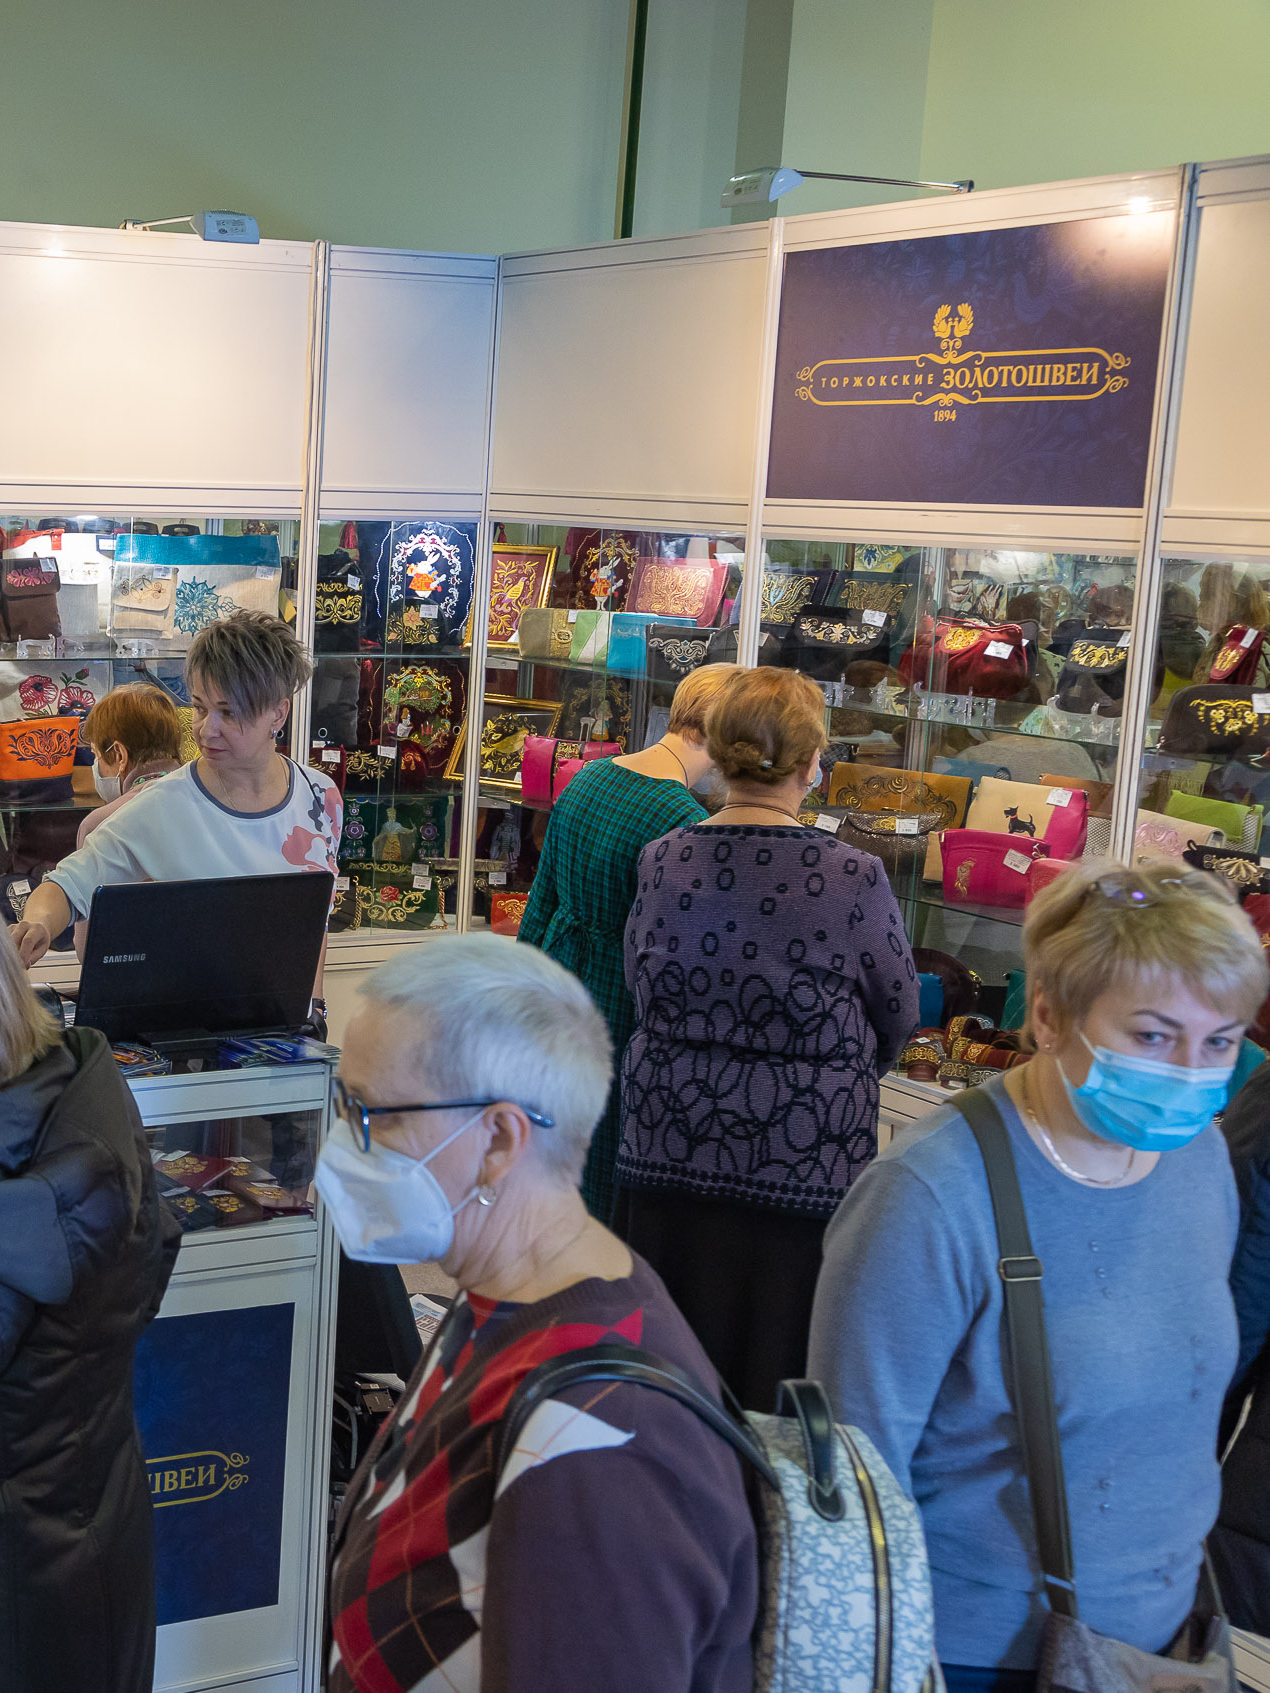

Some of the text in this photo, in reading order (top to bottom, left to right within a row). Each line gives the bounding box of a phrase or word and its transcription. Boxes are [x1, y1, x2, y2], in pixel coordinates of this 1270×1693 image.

[821, 362, 1100, 389] ТОРЖОКСКИЕ ЗОЛОТОШВЕИ
[933, 409, 957, 422] 1894
[103, 953, 147, 964] SAMSUNG
